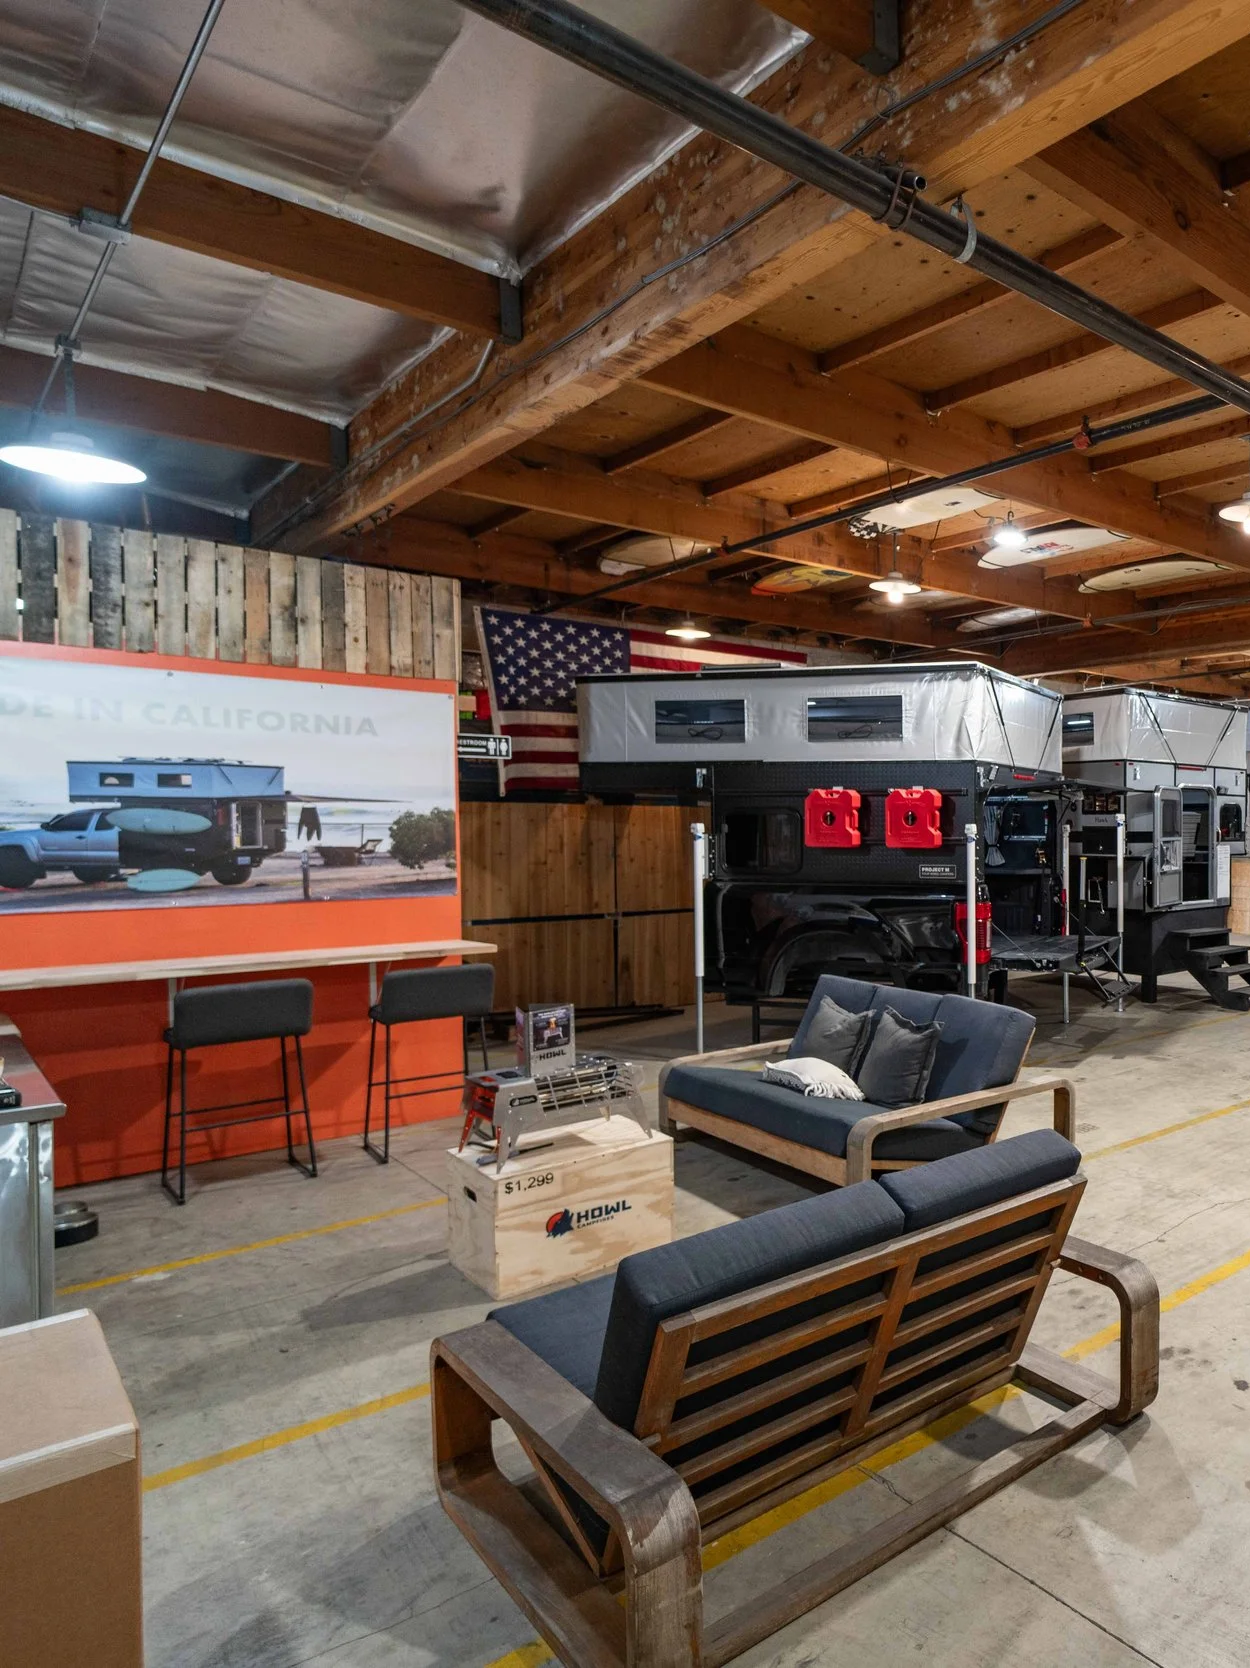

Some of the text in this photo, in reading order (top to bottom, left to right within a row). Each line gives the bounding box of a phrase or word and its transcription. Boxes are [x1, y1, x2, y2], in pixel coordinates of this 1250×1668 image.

[75, 697, 124, 723] IN
[143, 701, 379, 738] CALIFORNIA
[539, 1049, 566, 1061] HOWL
[504, 1172, 554, 1195] $1,299
[577, 1200, 632, 1223] HOWL
